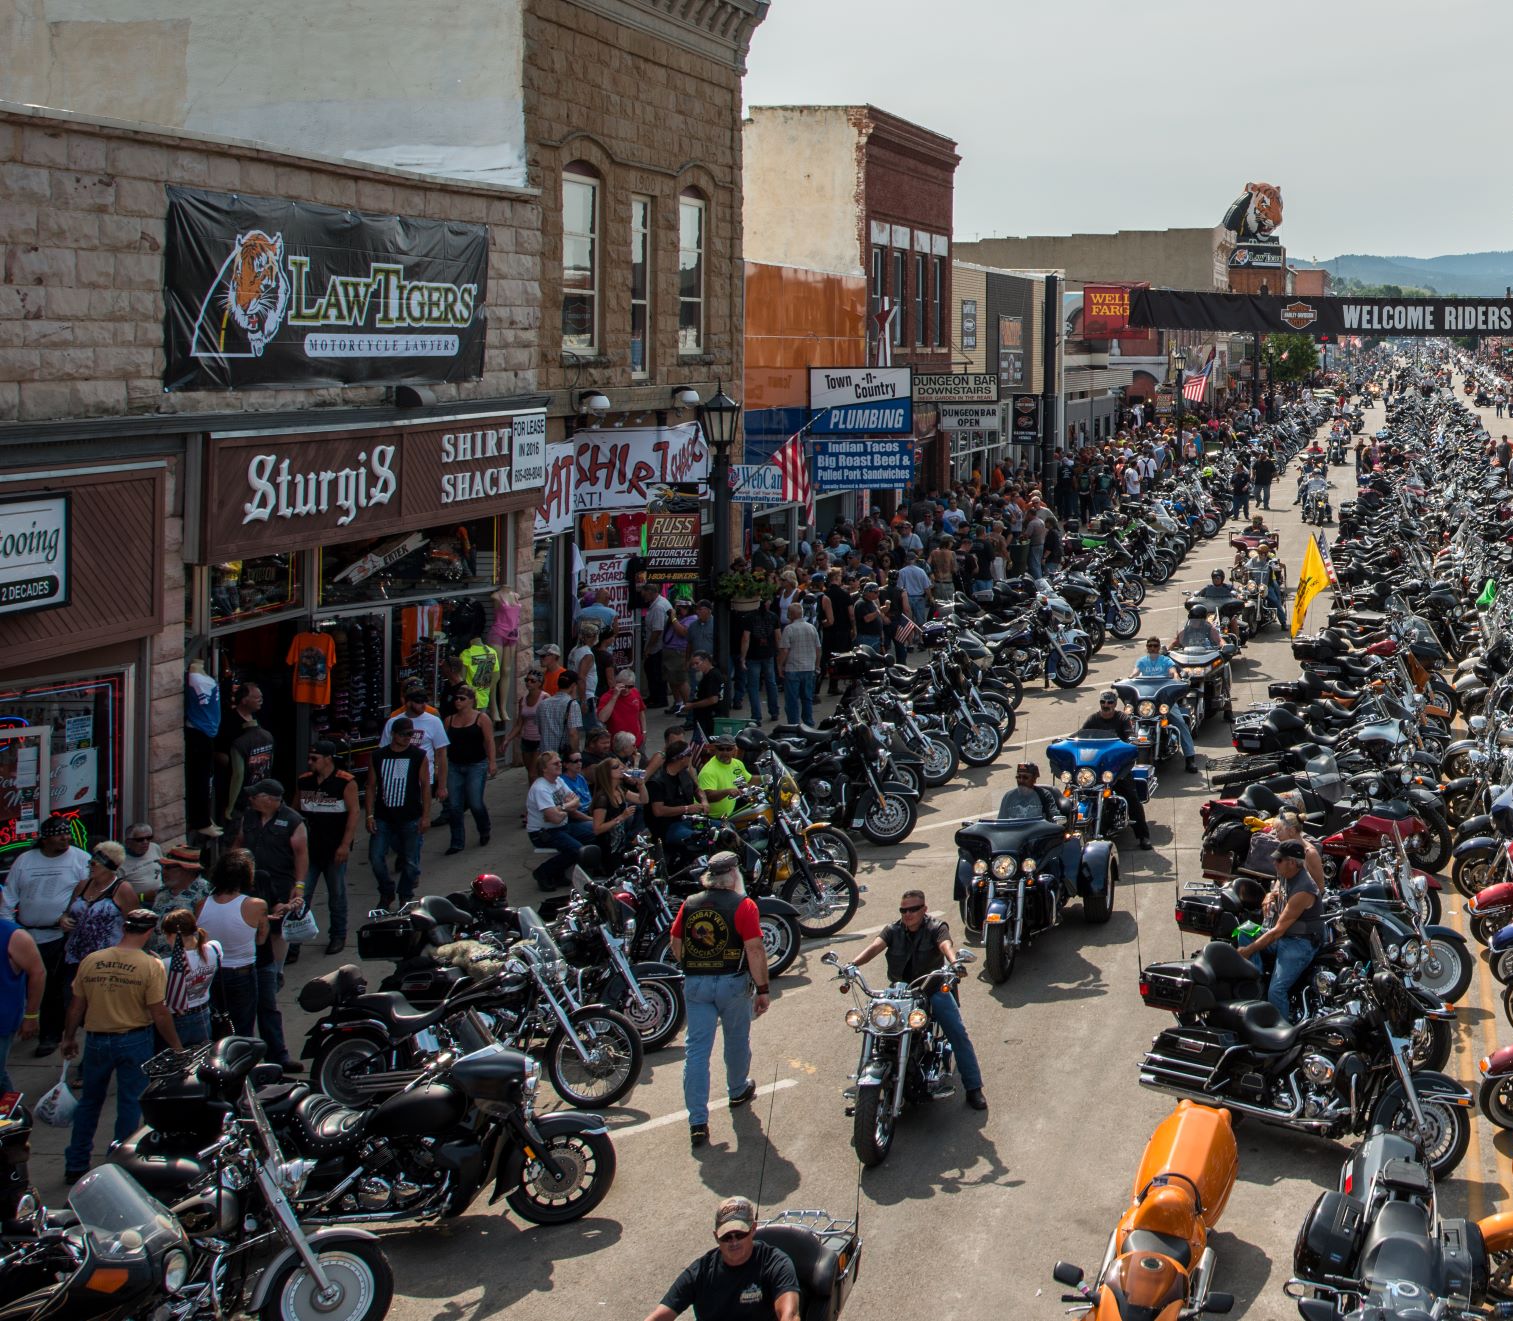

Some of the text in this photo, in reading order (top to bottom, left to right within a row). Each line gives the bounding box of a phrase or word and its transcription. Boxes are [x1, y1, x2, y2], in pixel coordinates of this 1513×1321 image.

[634, 175, 656, 191] 1900
[1090, 293, 1130, 304] WELL
[1090, 305, 1130, 315] FARG
[1343, 305, 1512, 330] WELCOME RIDERS
[309, 338, 456, 352] MOTORCYCLE LAWYERS
[825, 374, 852, 390] Town
[913, 375, 997, 387] DUNGEON BAR
[855, 382, 896, 399] Country
[918, 386, 991, 395] DOWNSTAIRS
[830, 408, 904, 429] PLUMBING
[942, 408, 997, 417] DUNGEON BAR
[514, 419, 545, 437] FOR LEASE
[957, 418, 980, 427] OPEN
[441, 428, 512, 463] SHIRT
[518, 442, 540, 457] IN 2016
[828, 441, 900, 452] Indian Tacos
[817, 454, 911, 468] Big Roast Beef &
[818, 468, 910, 481] Pulled Pork Sandwiches
[441, 467, 512, 503] SHACK
[651, 518, 696, 534] RUSS
[651, 535, 696, 548] BROWN
[648, 549, 700, 557] MOTORCYCLE
[599, 560, 622, 571] RAT
[649, 557, 697, 566] ATTORNEYS
[590, 572, 626, 583] BASTARD
[2, 581, 49, 600] 2 DECADES
[686, 911, 726, 931] COMBAT VETS
[686, 936, 727, 957] ASSOCIATION
